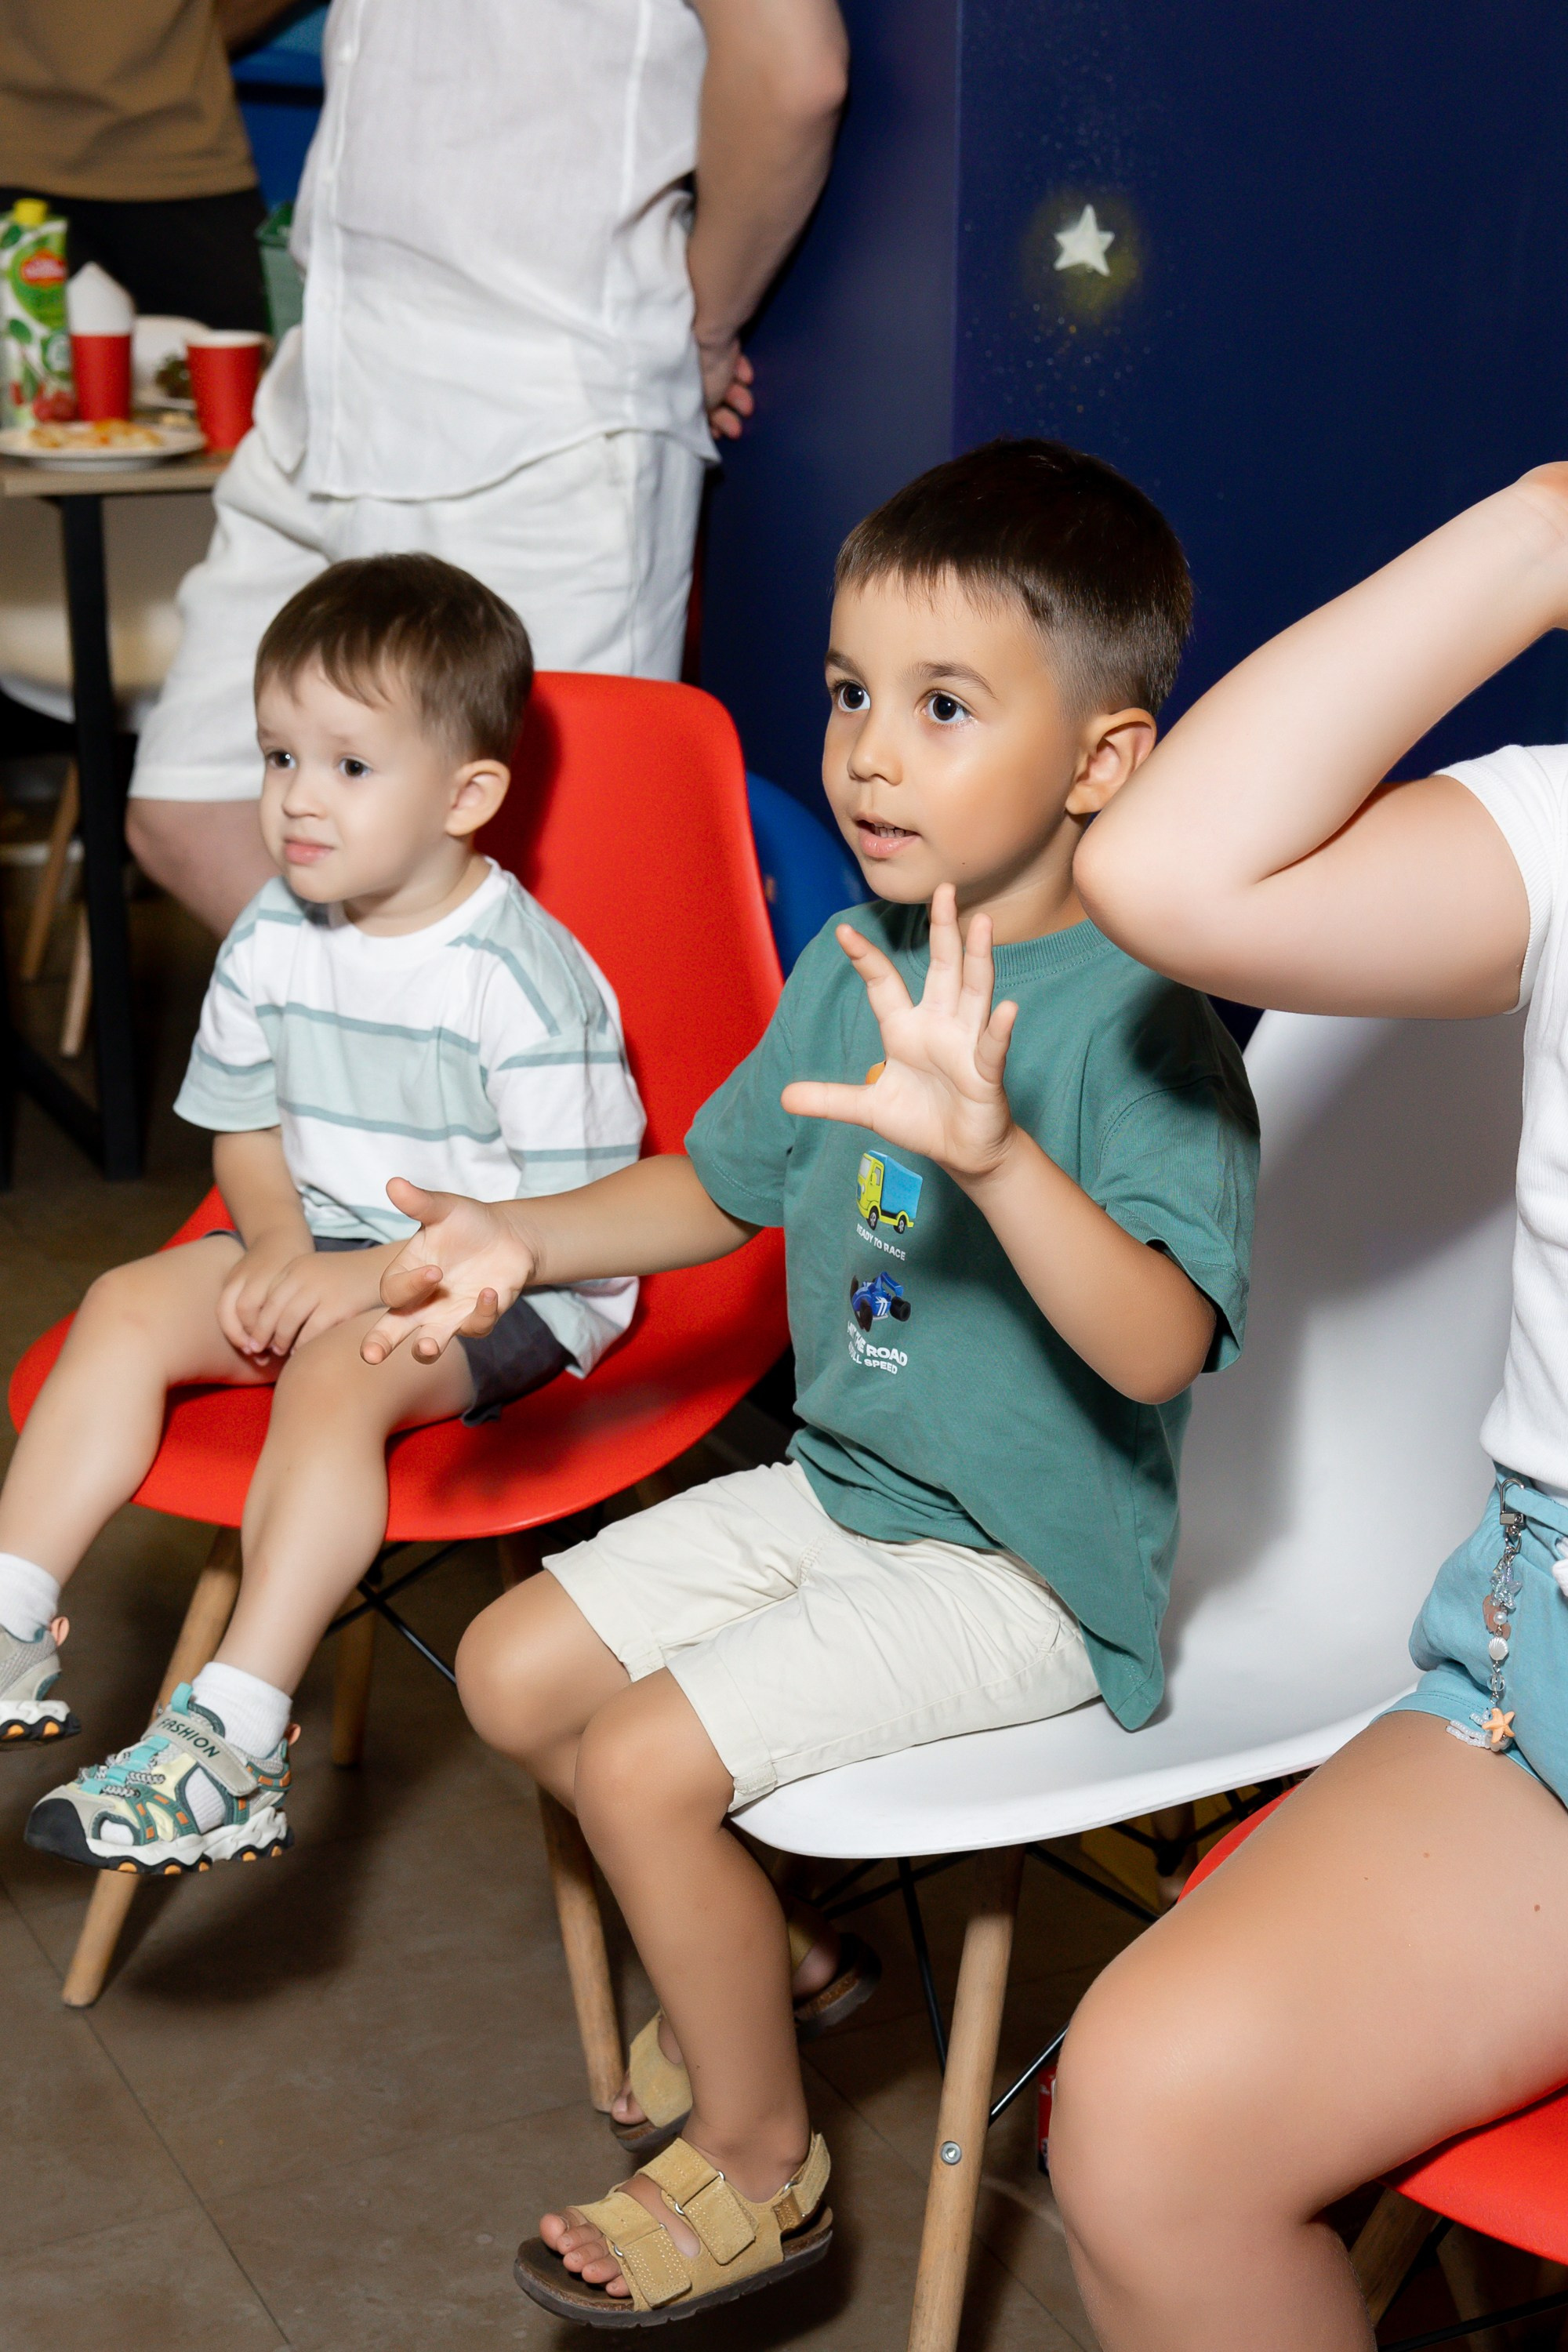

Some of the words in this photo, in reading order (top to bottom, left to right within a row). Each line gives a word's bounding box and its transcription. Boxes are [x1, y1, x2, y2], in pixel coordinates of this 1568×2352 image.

[856, 1223, 873, 1243] READY
[874, 1237, 882, 1249] TO
[884, 1243, 906, 1261] RACE
[864, 1359, 897, 1374] SPEED
[866, 1344, 907, 1367] ROAD
[157, 1719, 220, 1757] FASHION
